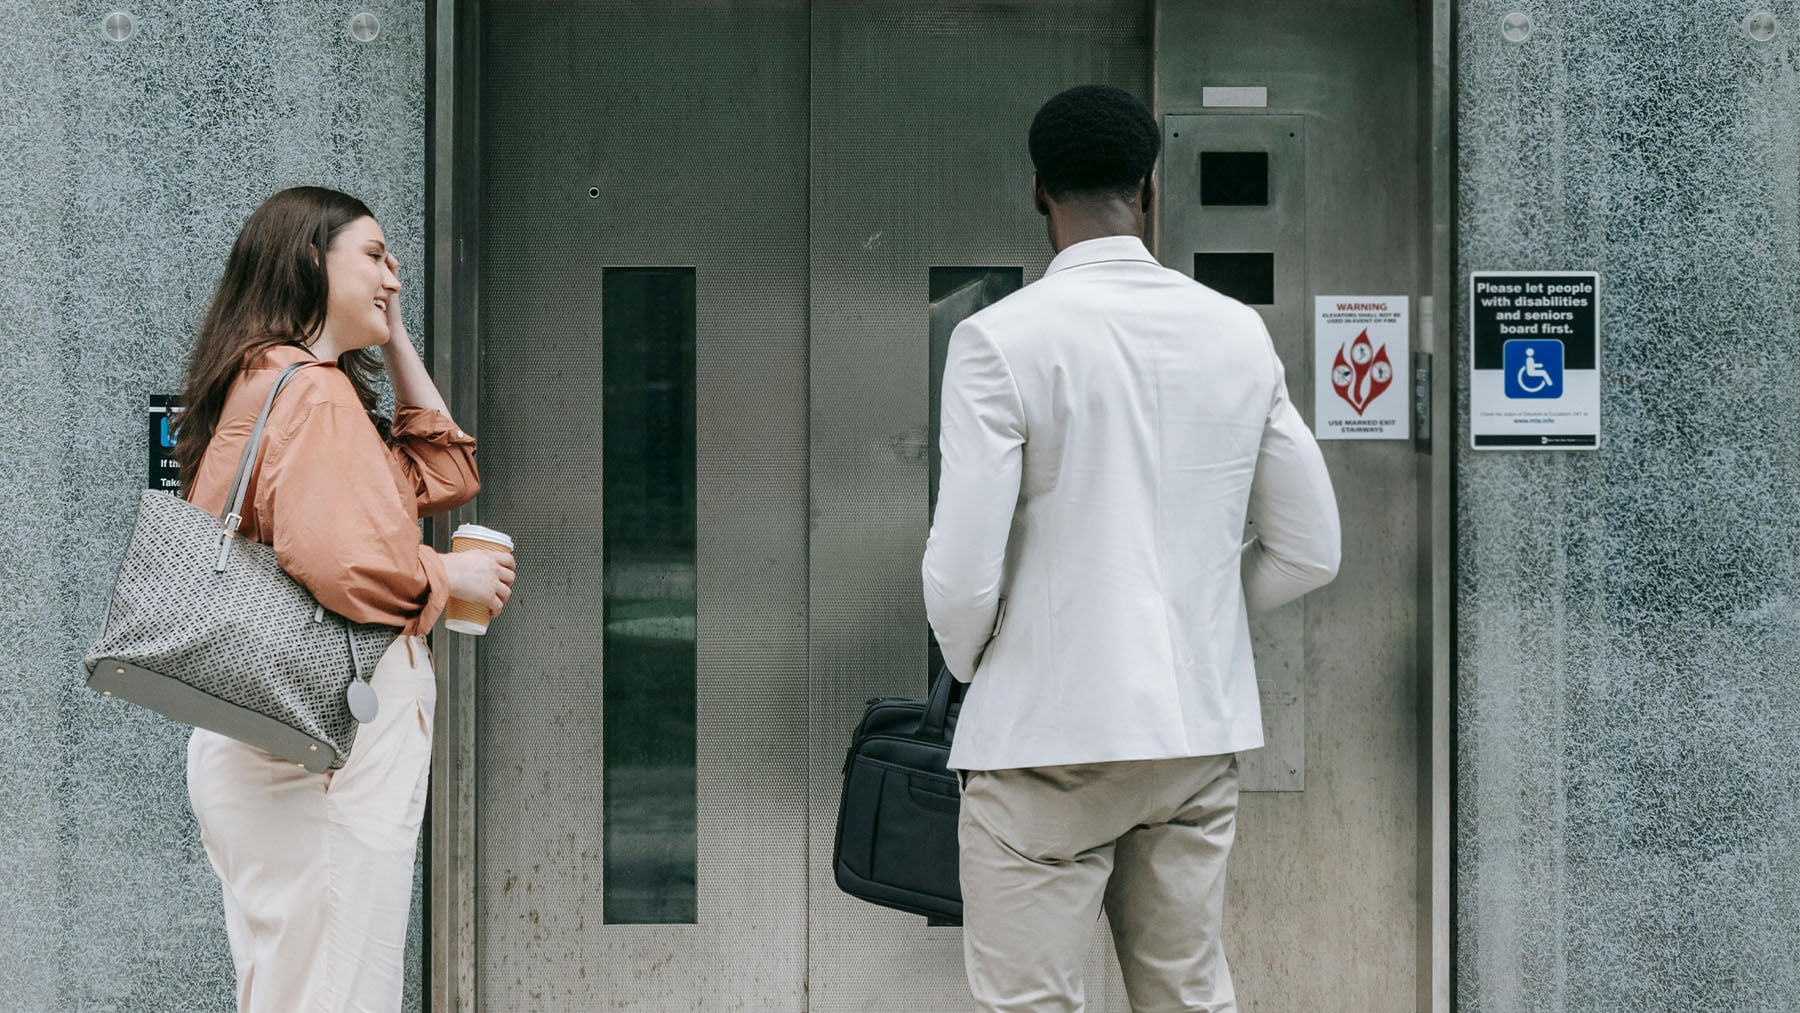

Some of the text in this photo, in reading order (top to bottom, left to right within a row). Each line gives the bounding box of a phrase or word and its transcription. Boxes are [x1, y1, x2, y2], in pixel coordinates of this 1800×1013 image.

[1477, 283, 1593, 295] Please let people
[1481, 296, 1588, 307] with disabilities
[1336, 303, 1388, 311] WARNING
[1496, 310, 1574, 320] and seniors
[1500, 324, 1574, 334] board first.
[160, 459, 167, 468] If
[160, 478, 181, 487] Take
